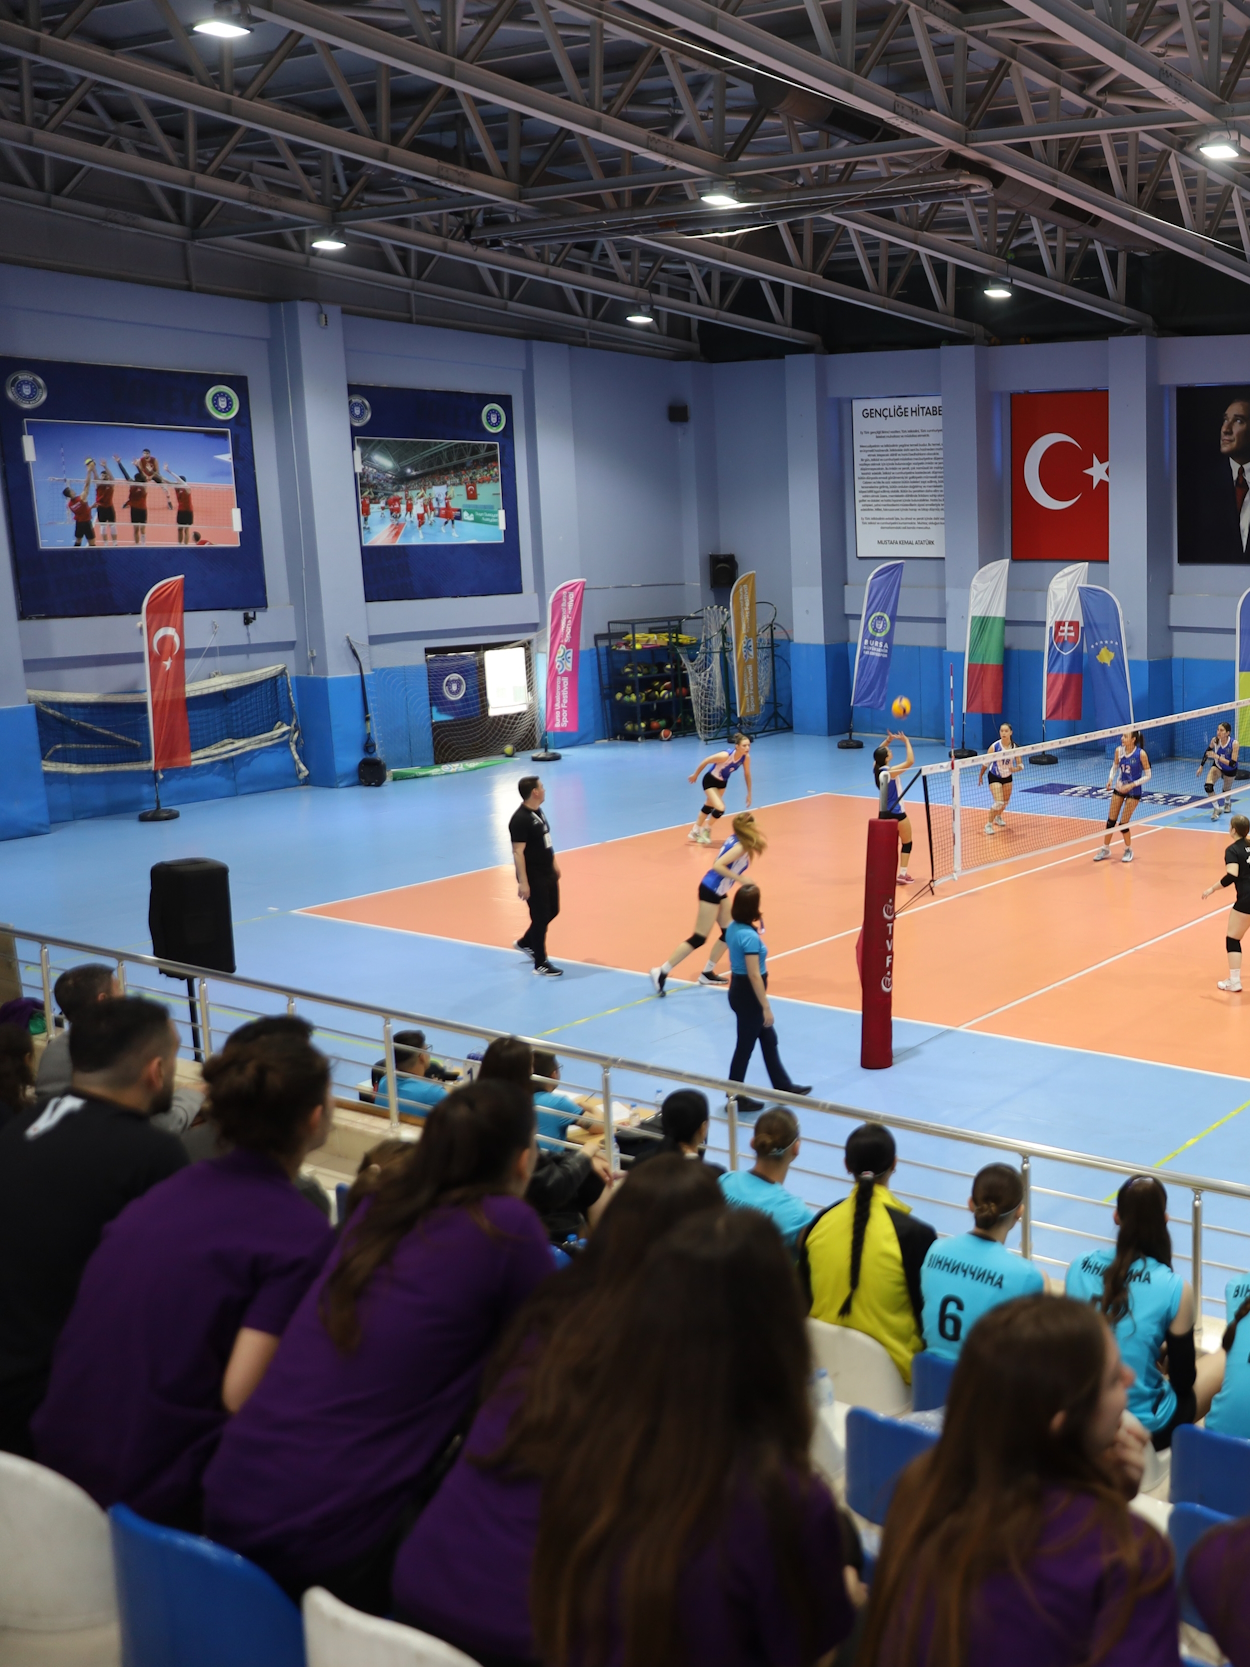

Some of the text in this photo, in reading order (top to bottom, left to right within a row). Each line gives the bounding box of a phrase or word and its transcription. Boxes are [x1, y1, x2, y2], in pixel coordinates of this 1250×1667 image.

[862, 404, 942, 420] GENÇLİĞE HİTABE
[864, 639, 889, 649] BURSA
[561, 677, 569, 707] Festivali
[927, 1253, 1004, 1289] ВІННИЧЧИНА
[938, 1293, 965, 1342] 6
